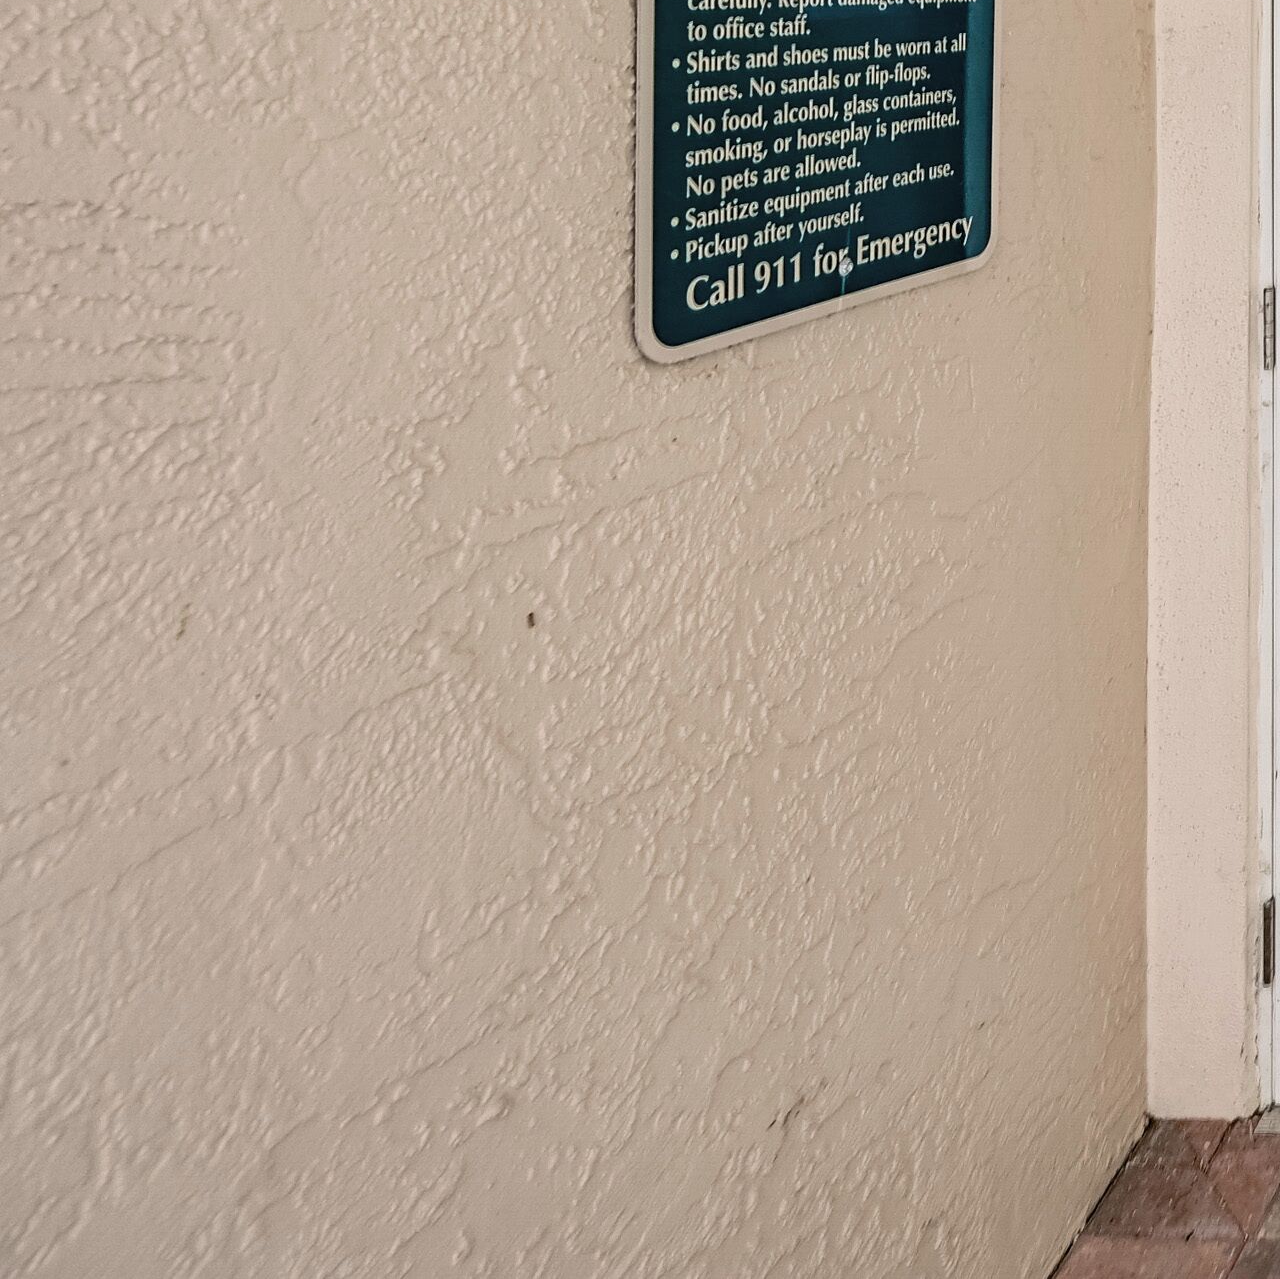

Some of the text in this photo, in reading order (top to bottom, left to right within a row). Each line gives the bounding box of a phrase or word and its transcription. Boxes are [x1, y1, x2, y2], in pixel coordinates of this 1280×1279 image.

[686, 33, 967, 74] Shirts and shoes must be worn at all
[687, 14, 811, 42] to office staff.
[686, 62, 931, 104] times. No sandals or flip-flops.
[685, 108, 960, 168] smoking, or horseplay is permitted.
[686, 88, 957, 137] No food, alcohol, glass containers,
[685, 162, 954, 231] Sanitize equipment after each use.
[686, 148, 861, 199] No pets are allowed.
[685, 203, 864, 262] Pickup after yourself.
[686, 216, 974, 311] Call 911 for Emergency
